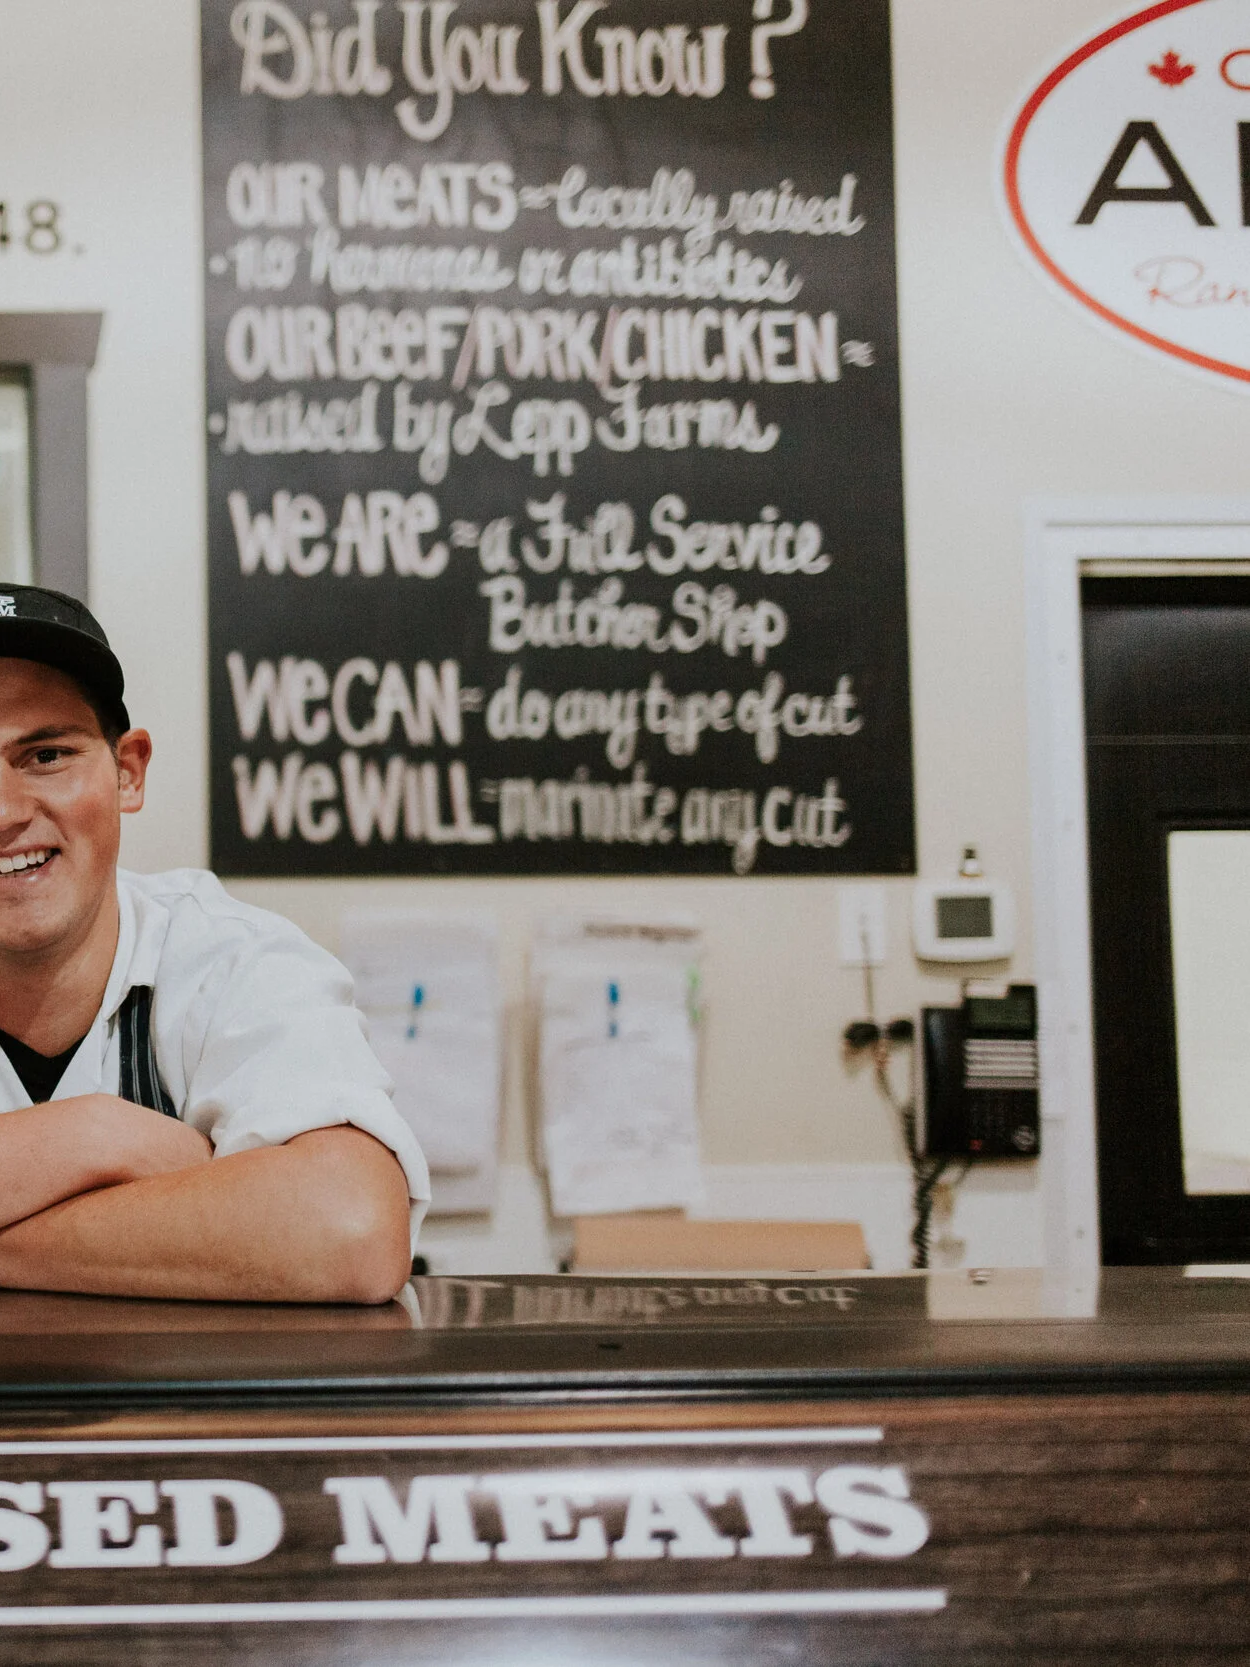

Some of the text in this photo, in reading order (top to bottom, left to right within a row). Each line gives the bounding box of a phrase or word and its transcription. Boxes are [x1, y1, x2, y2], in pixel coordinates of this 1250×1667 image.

[231, 0, 391, 97] Did
[395, 0, 528, 141] You
[226, 162, 332, 230] OUR
[717, 172, 866, 236] raised
[1074, 120, 1250, 227] A
[570, 236, 803, 303] antibiotics
[225, 304, 335, 382] OUR
[221, 380, 781, 485] raised by Lepp Farms
[478, 516, 518, 573] a
[520, 491, 645, 575] Full
[647, 494, 833, 575] Service
[478, 575, 788, 667] Butcher Shop
[331, 657, 463, 747] CAN
[485, 663, 549, 740] do
[553, 687, 647, 769] any
[645, 671, 734, 756] type
[735, 669, 785, 764] of
[781, 674, 863, 737] cut
[338, 750, 496, 845] WILL
[681, 786, 763, 876] any
[323, 1464, 932, 1562] MEATS
